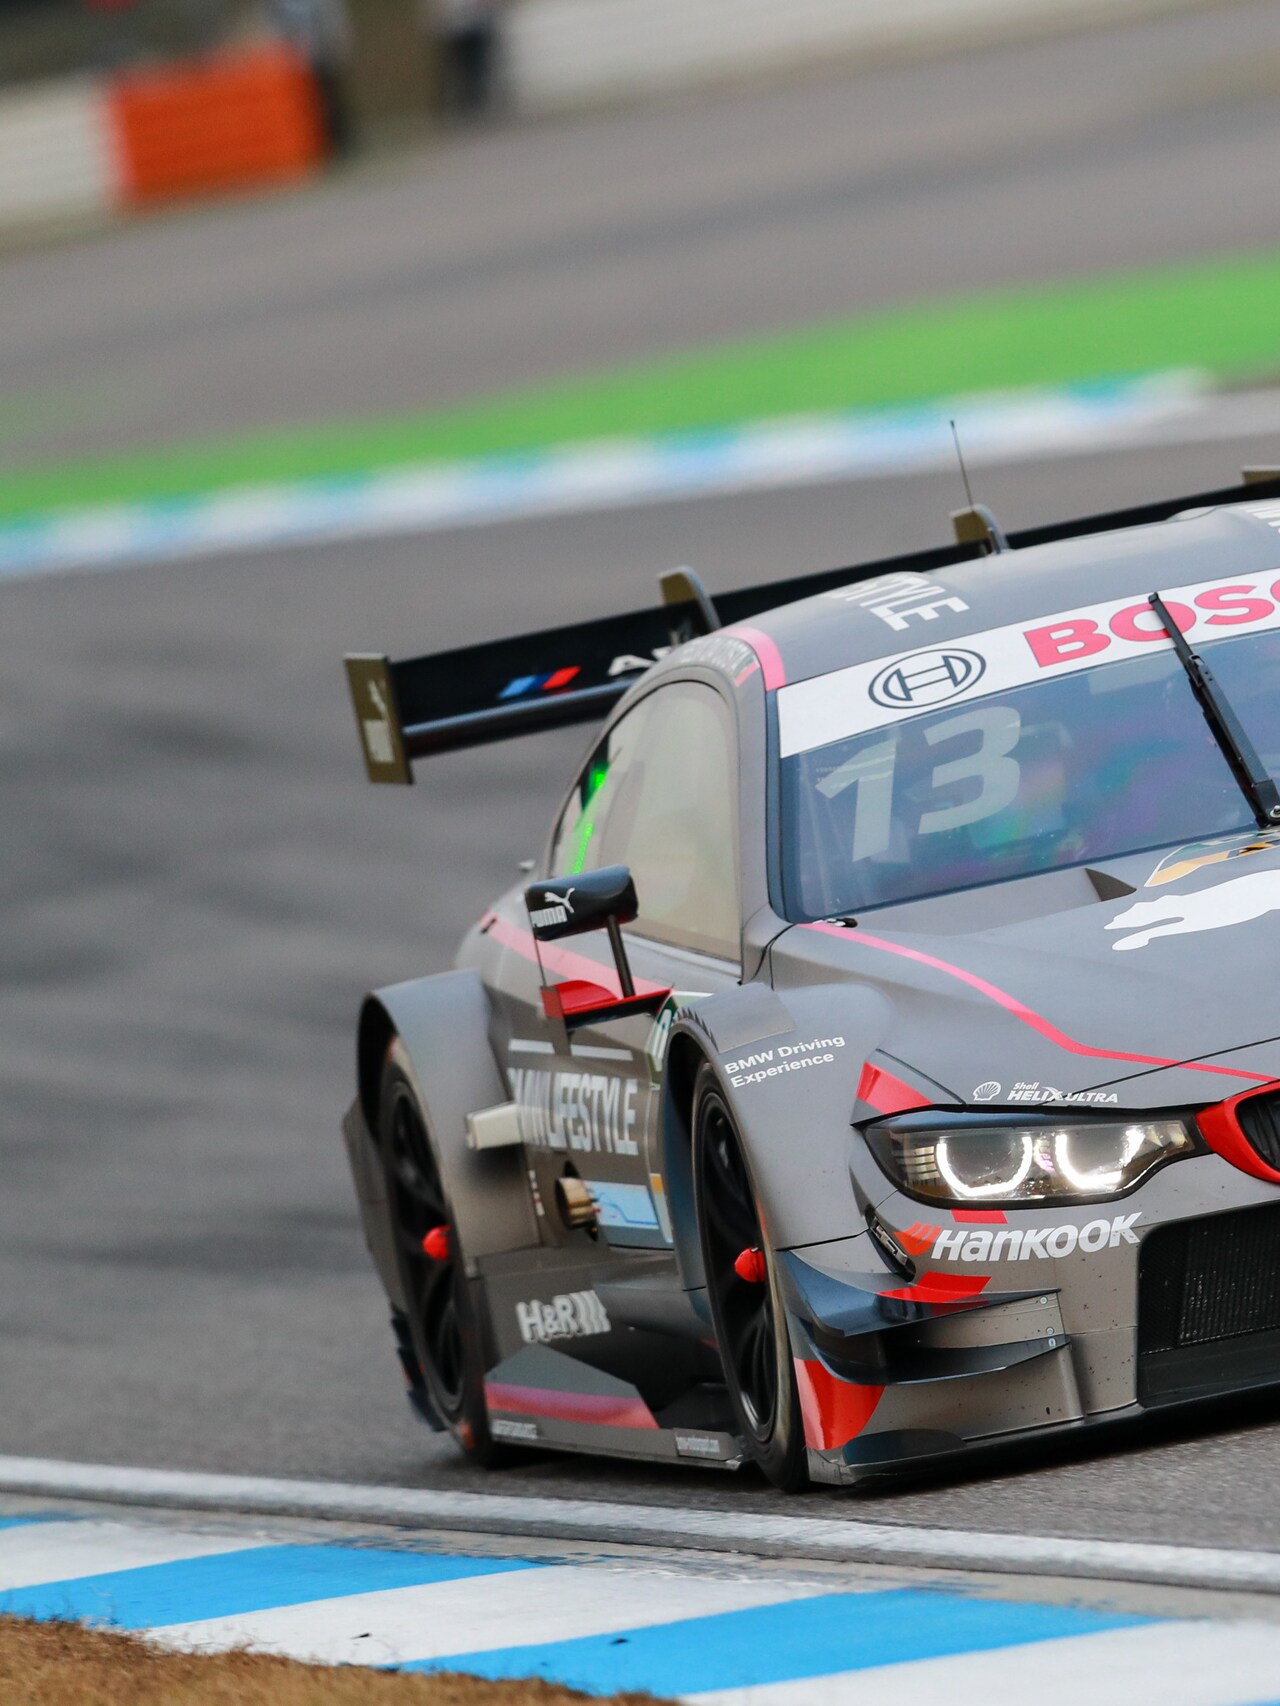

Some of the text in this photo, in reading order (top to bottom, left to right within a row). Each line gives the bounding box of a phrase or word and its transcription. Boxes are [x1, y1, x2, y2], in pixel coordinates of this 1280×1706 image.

[814, 706, 1022, 863] 13
[724, 1036, 846, 1074] BMW Driving
[730, 1053, 835, 1088] Experience
[1007, 1086, 1119, 1103] HELIX ULTRA
[1013, 1081, 1040, 1090] Shell
